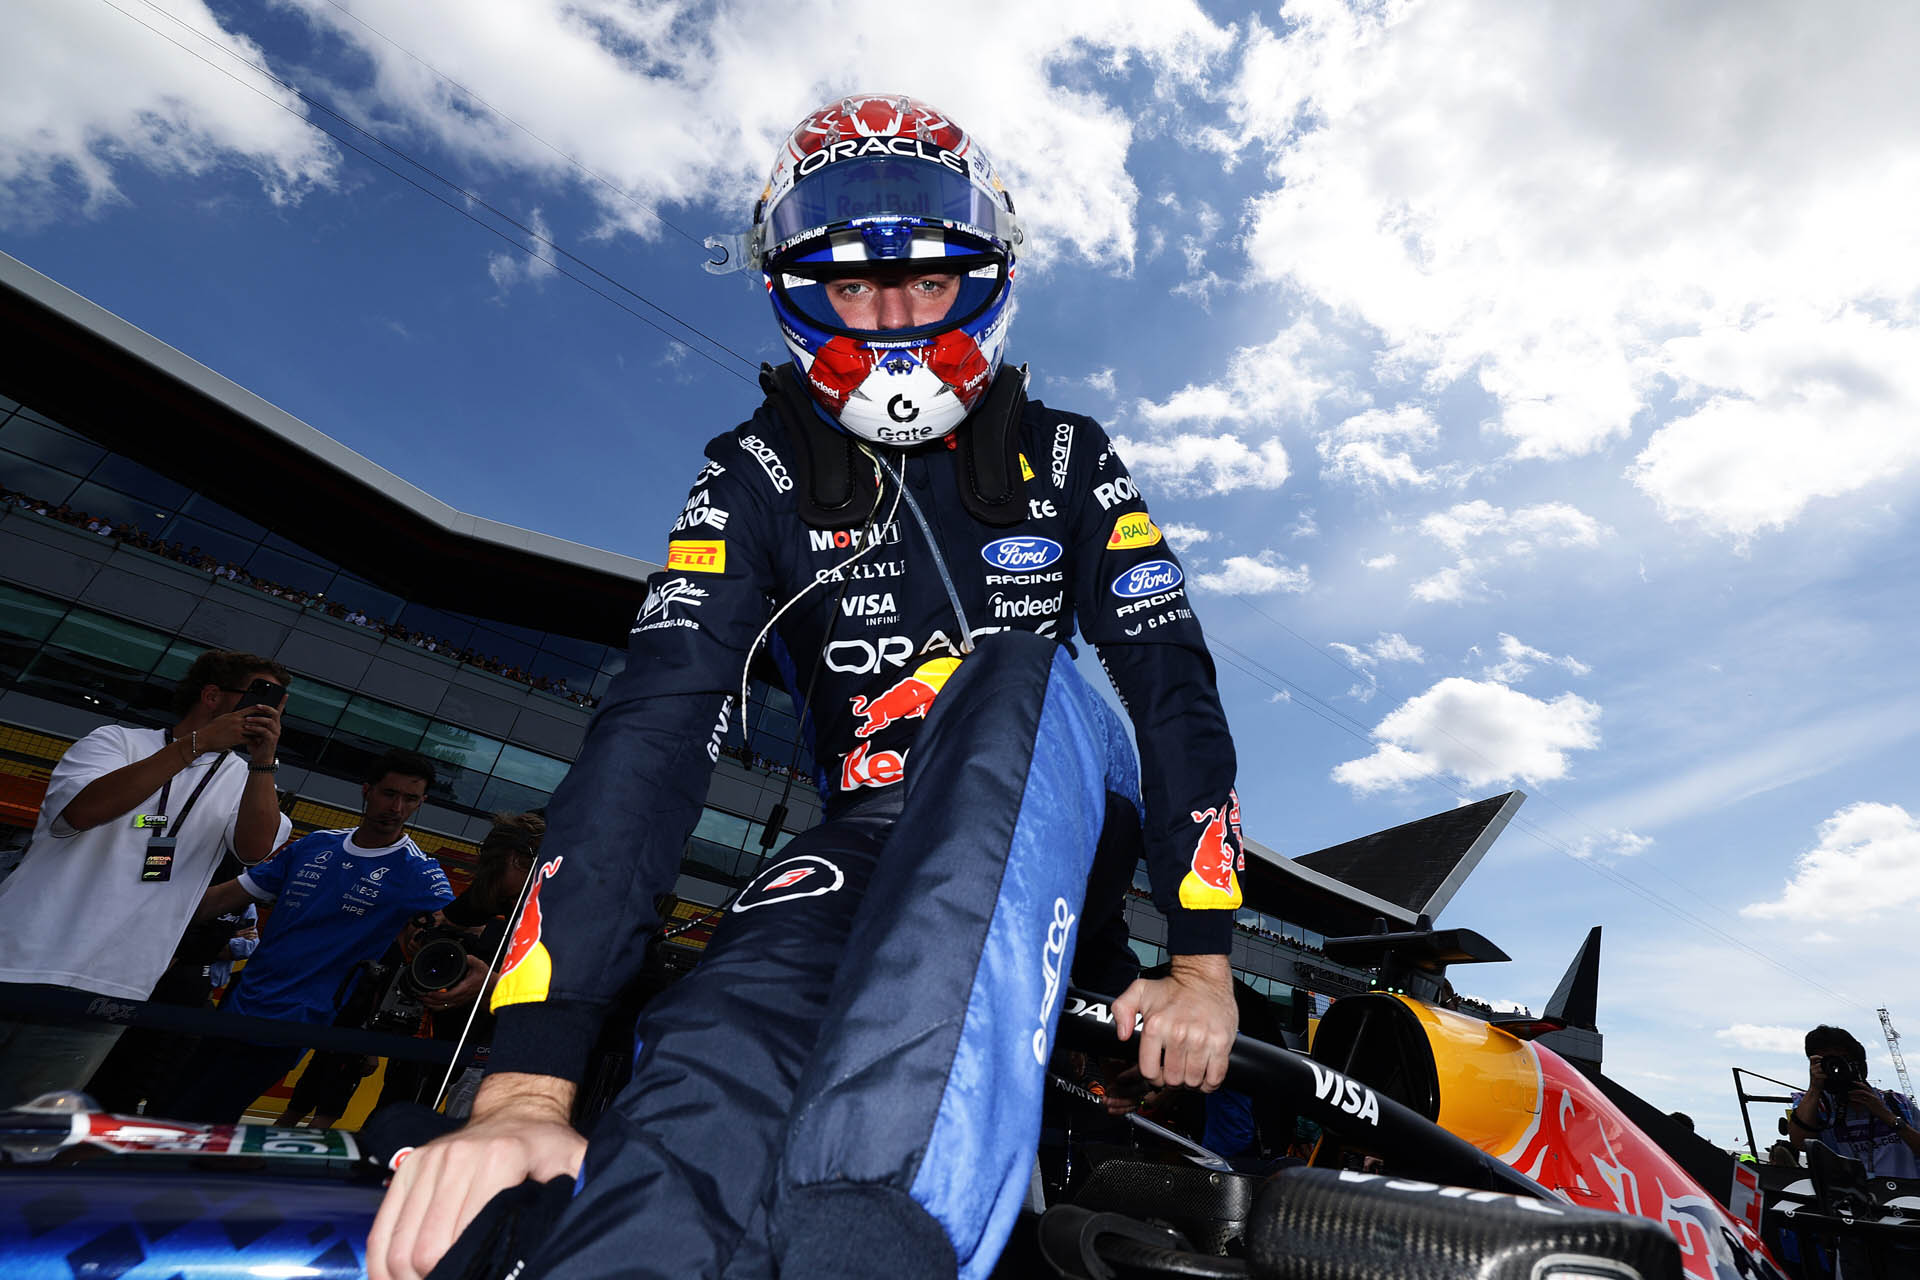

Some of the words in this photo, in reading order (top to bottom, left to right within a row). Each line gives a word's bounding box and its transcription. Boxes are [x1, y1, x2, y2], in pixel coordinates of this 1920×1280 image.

[799, 137, 964, 175] ORACLE
[837, 193, 881, 216] Red
[886, 192, 930, 215] Bull
[866, 338, 928, 348] VERSTAPPEN.COM
[810, 374, 841, 399] indeed
[962, 364, 991, 392] indeed
[877, 425, 933, 441] Gate
[739, 435, 794, 494] sparco
[1052, 423, 1074, 489] sparco
[1092, 475, 1143, 511] ROK
[670, 506, 730, 534] RADE
[1027, 499, 1058, 520] te
[669, 554, 715, 566] ELLI
[996, 541, 1047, 566] Ford
[985, 571, 1063, 586] RACING
[1128, 564, 1174, 594] Ford
[841, 593, 897, 616] VISA
[988, 591, 1063, 618] indeed
[1115, 588, 1185, 618] RACIN
[838, 740, 911, 791] Re
[1303, 1059, 1380, 1127] VISA
